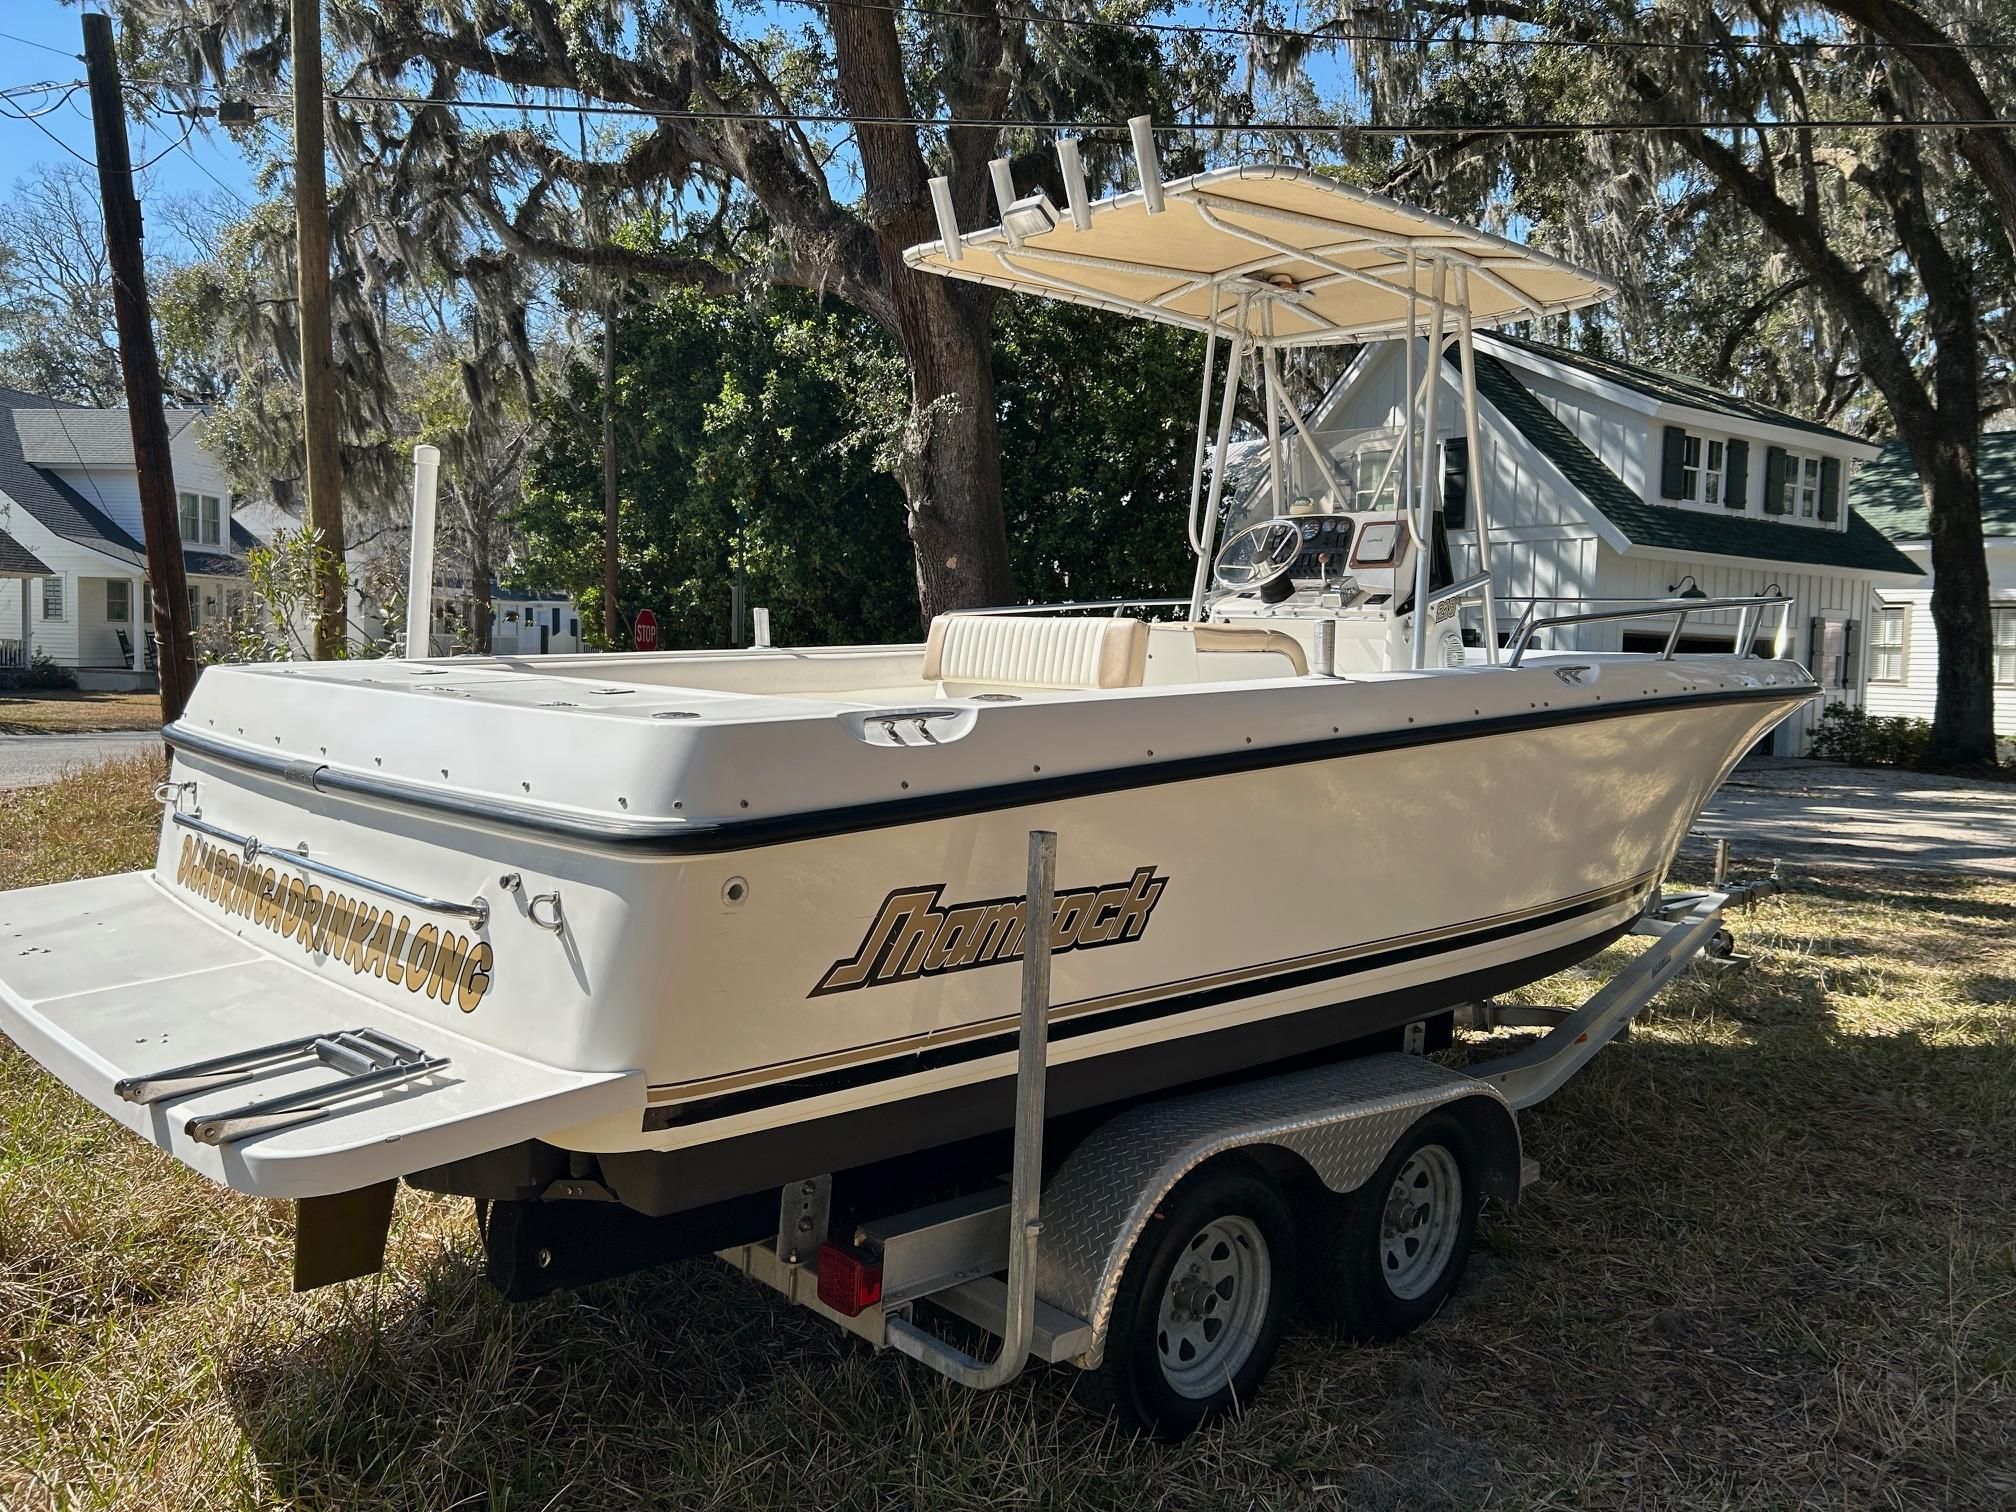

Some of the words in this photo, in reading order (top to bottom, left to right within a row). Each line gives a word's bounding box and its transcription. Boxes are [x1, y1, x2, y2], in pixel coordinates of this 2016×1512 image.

[637, 625, 656, 642] STOP
[177, 834, 494, 1013] DIJABRINGADRINKALONG
[806, 865, 1169, 999] Shamock
